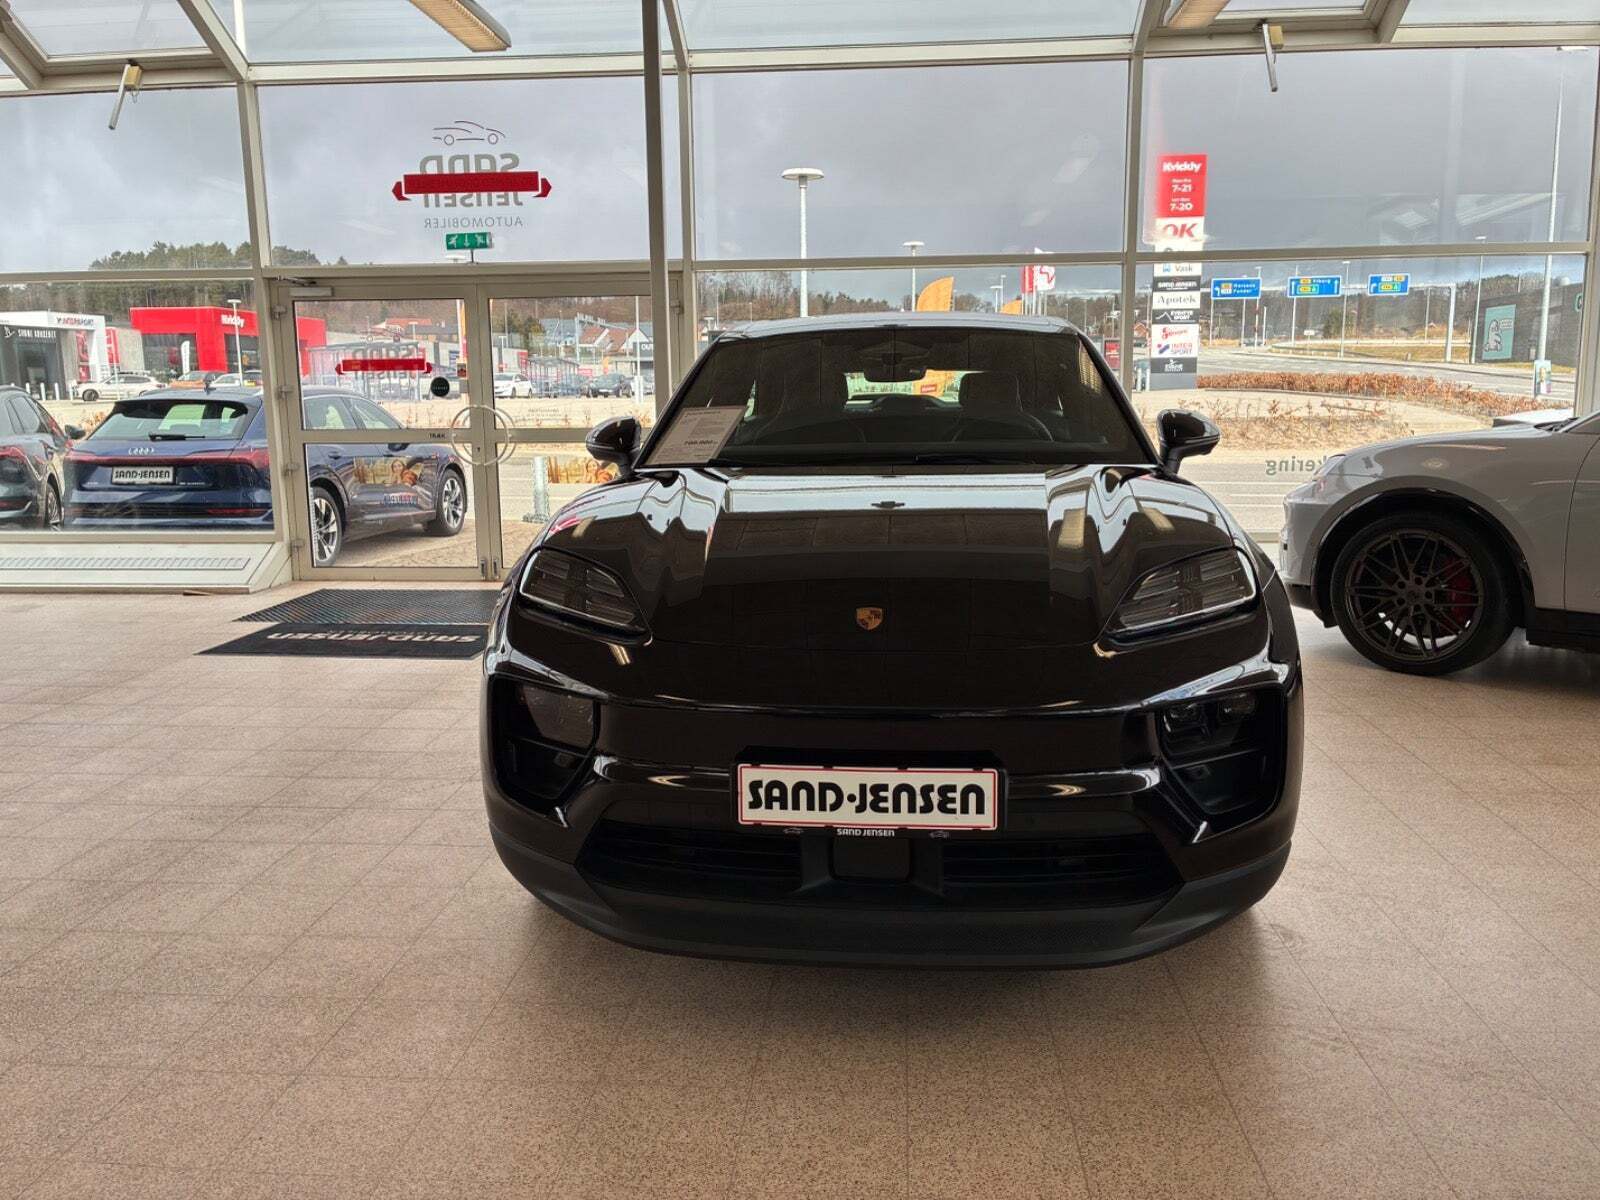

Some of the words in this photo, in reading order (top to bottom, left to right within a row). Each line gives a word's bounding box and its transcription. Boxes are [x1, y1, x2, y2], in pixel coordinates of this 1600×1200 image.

[1157, 295, 1197, 306] Apotek
[836, 828, 862, 837] SAND
[862, 828, 895, 838] JENSEN
